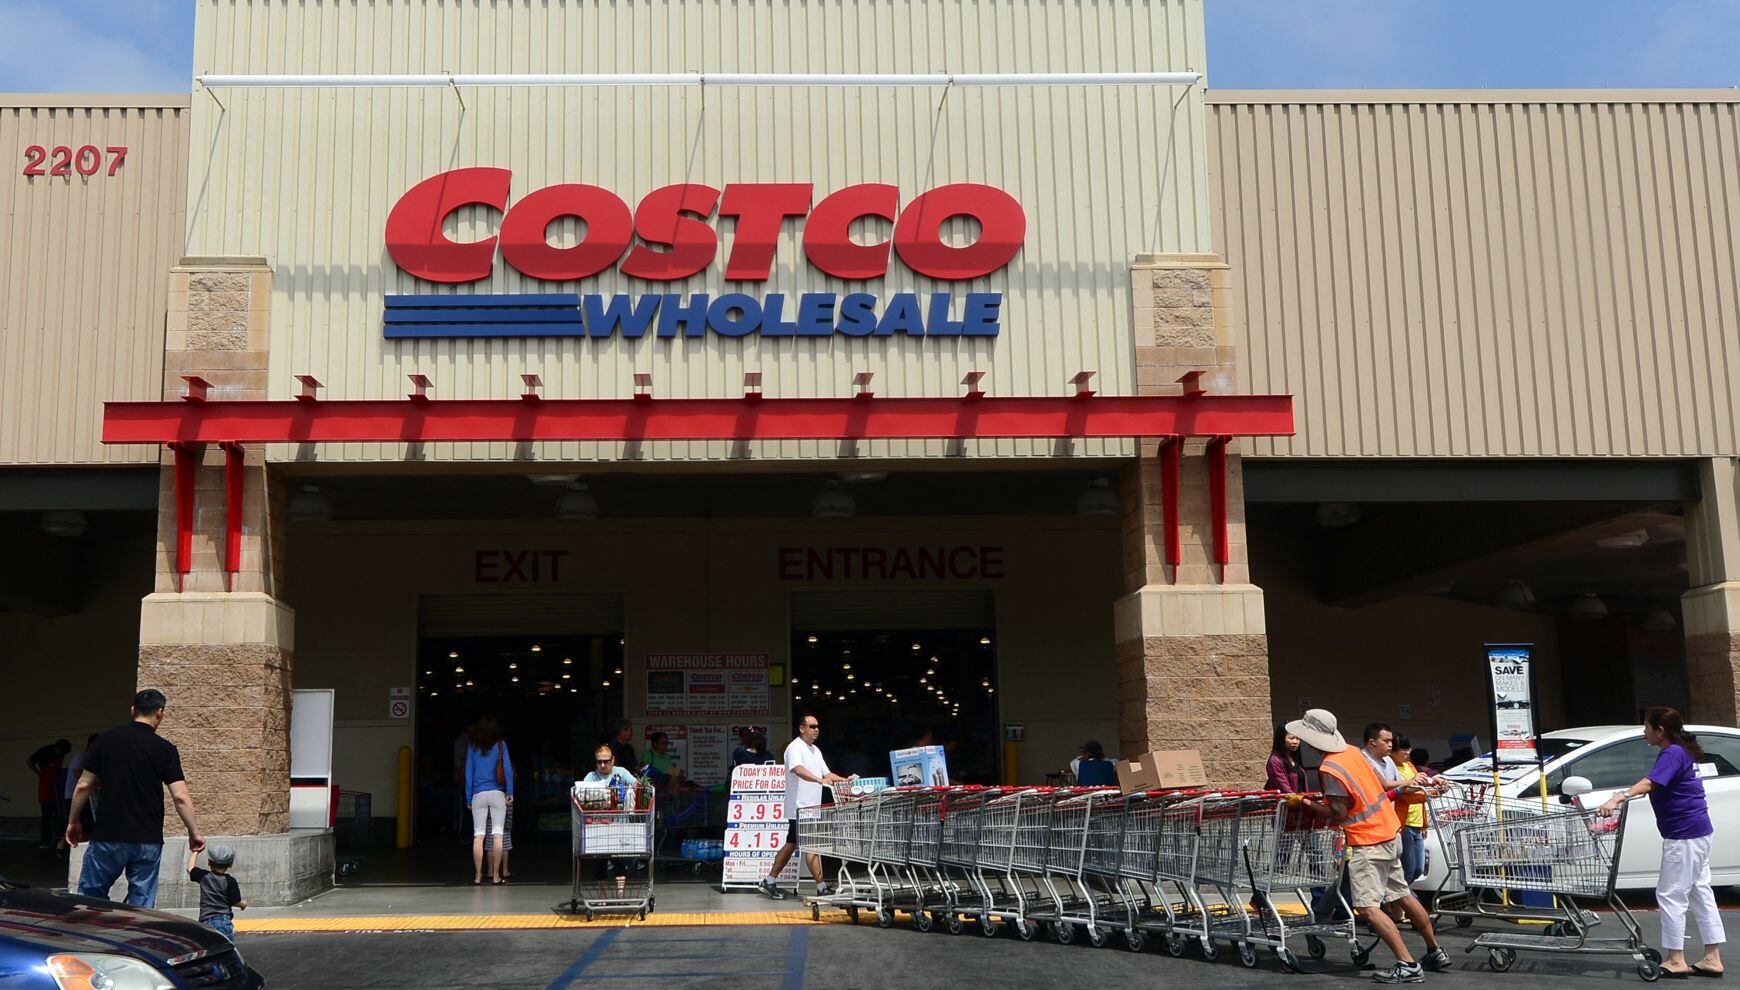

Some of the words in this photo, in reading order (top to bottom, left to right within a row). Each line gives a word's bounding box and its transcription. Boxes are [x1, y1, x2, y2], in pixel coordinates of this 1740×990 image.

[23, 145, 128, 176] 2207
[385, 166, 1026, 284] COSTCO
[582, 292, 1003, 339] WHOLESALE
[474, 549, 568, 583] EXIT
[778, 545, 1006, 581] ENTRANCE
[649, 655, 722, 668] WAREHOUSE
[725, 655, 766, 668] HOURS
[1495, 666, 1524, 675] SAVE
[1496, 685, 1526, 693] MODELS
[739, 766, 768, 777] TODAY'S
[732, 779, 754, 790] PRICE
[755, 779, 769, 789] FOR
[771, 779, 786, 790] GAS
